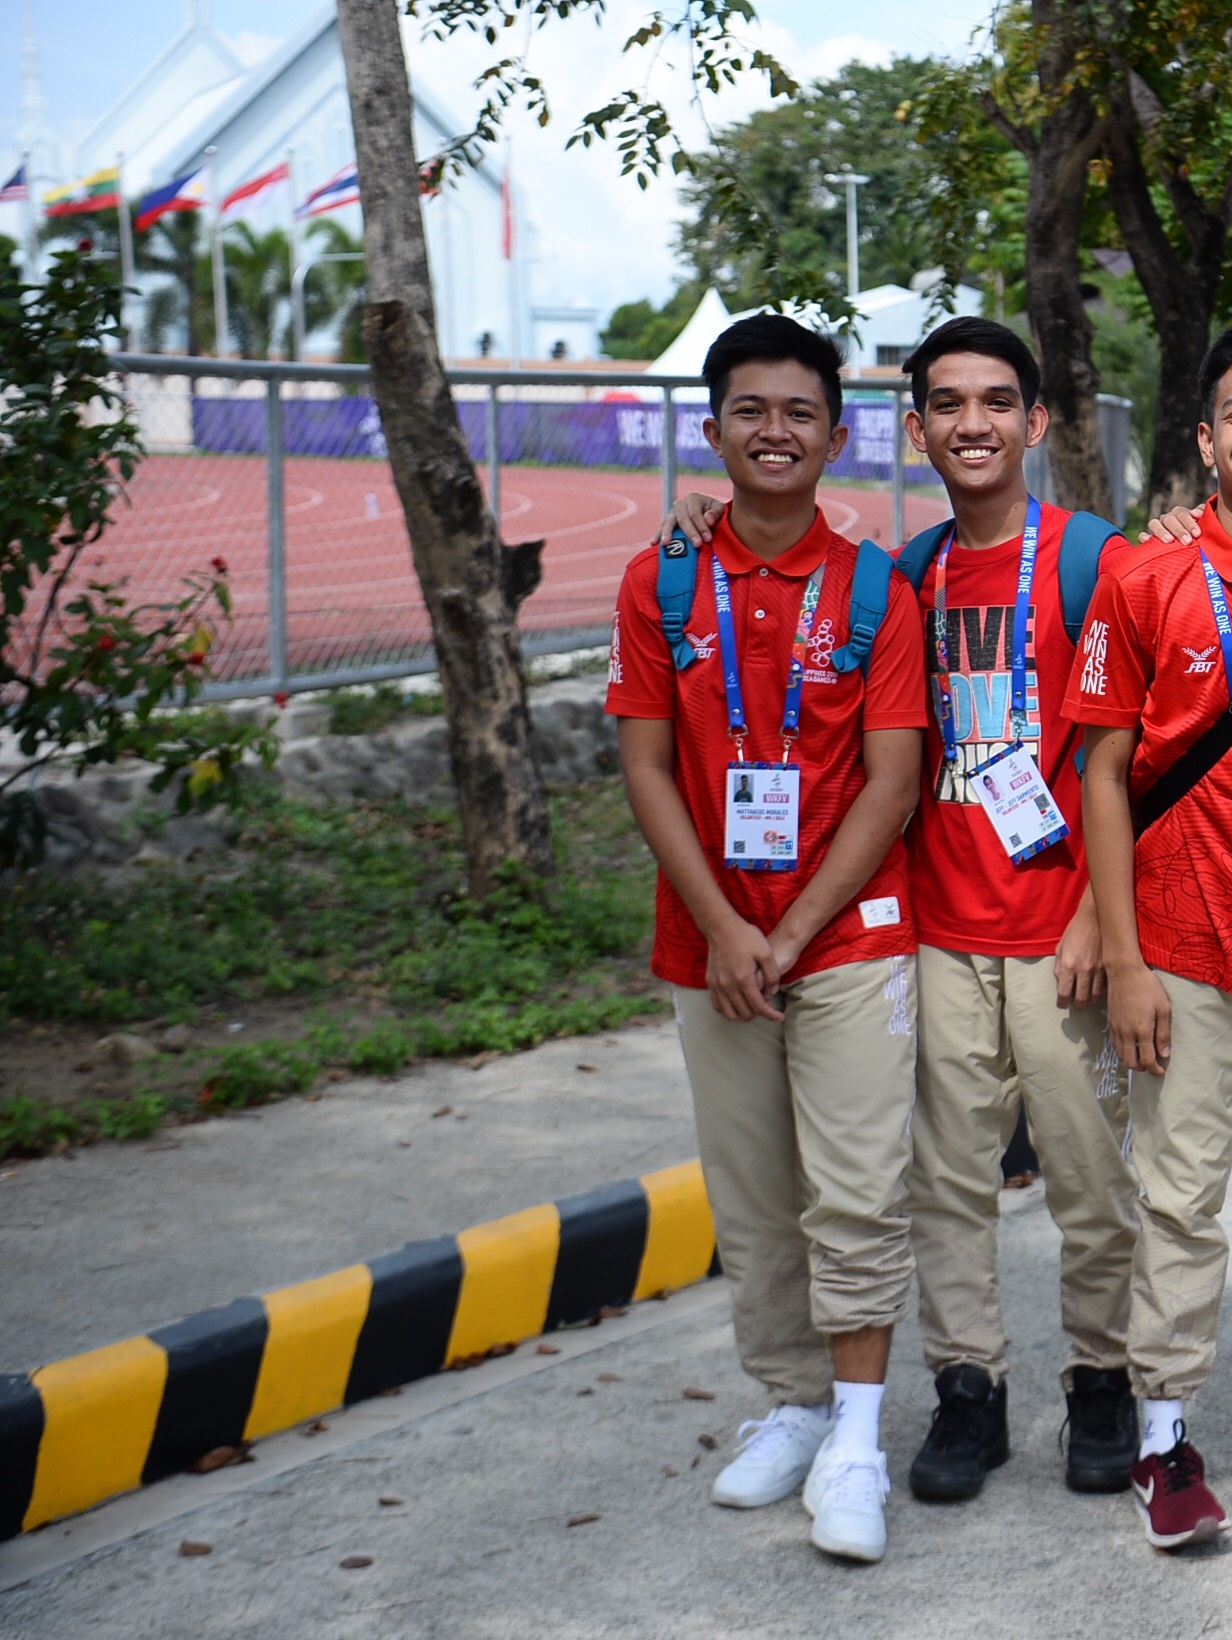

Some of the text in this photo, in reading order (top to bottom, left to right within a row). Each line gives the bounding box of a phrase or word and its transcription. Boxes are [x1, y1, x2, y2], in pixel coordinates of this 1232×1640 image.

[1017, 526, 1038, 594] WE WIN AS ONE
[714, 581, 728, 593] AS
[1207, 577, 1223, 598] WIN
[716, 595, 730, 613] ONE
[1212, 600, 1226, 613] AS
[1216, 615, 1232, 635] ONE
[1084, 656, 1105, 676] AS
[1184, 662, 1216, 674] FBT
